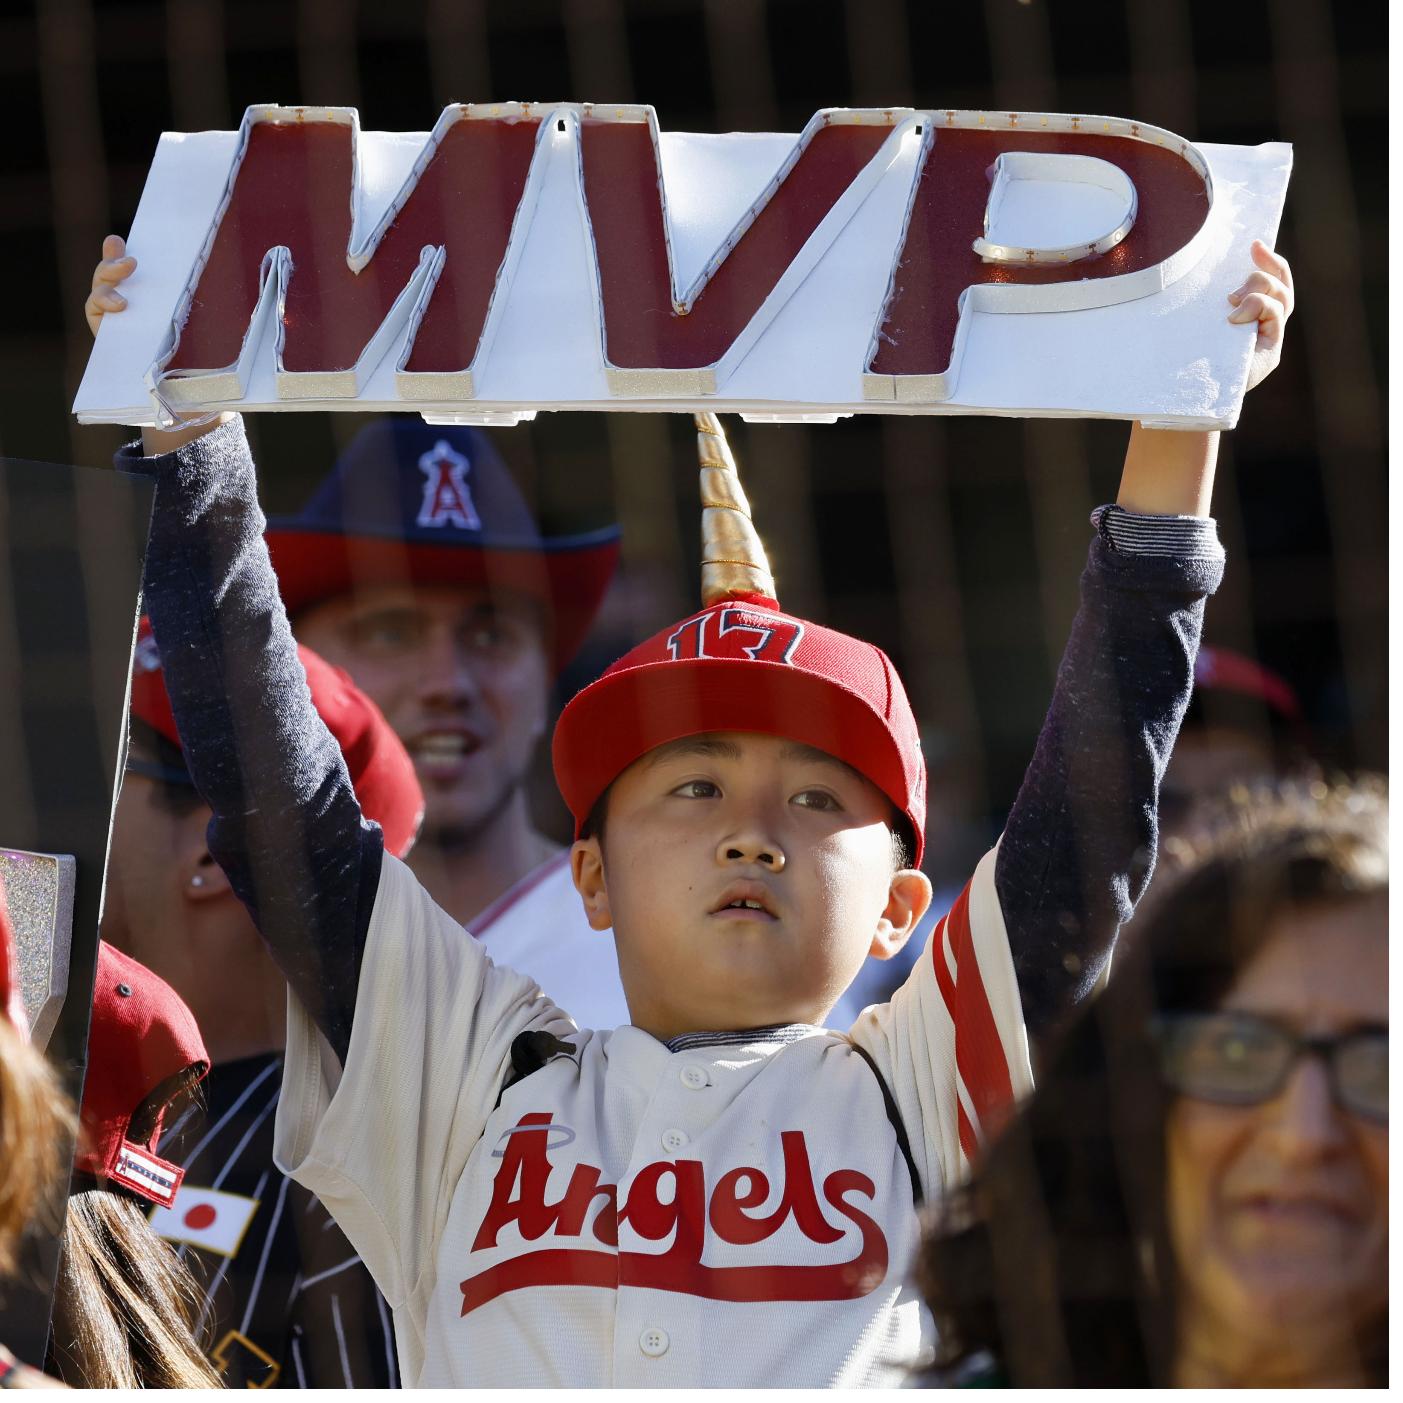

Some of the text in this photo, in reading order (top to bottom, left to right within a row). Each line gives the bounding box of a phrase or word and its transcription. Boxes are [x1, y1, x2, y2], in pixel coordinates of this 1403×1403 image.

[148, 102, 1214, 402] MVP
[667, 608, 805, 667] 17
[462, 1112, 889, 1308] Angels
